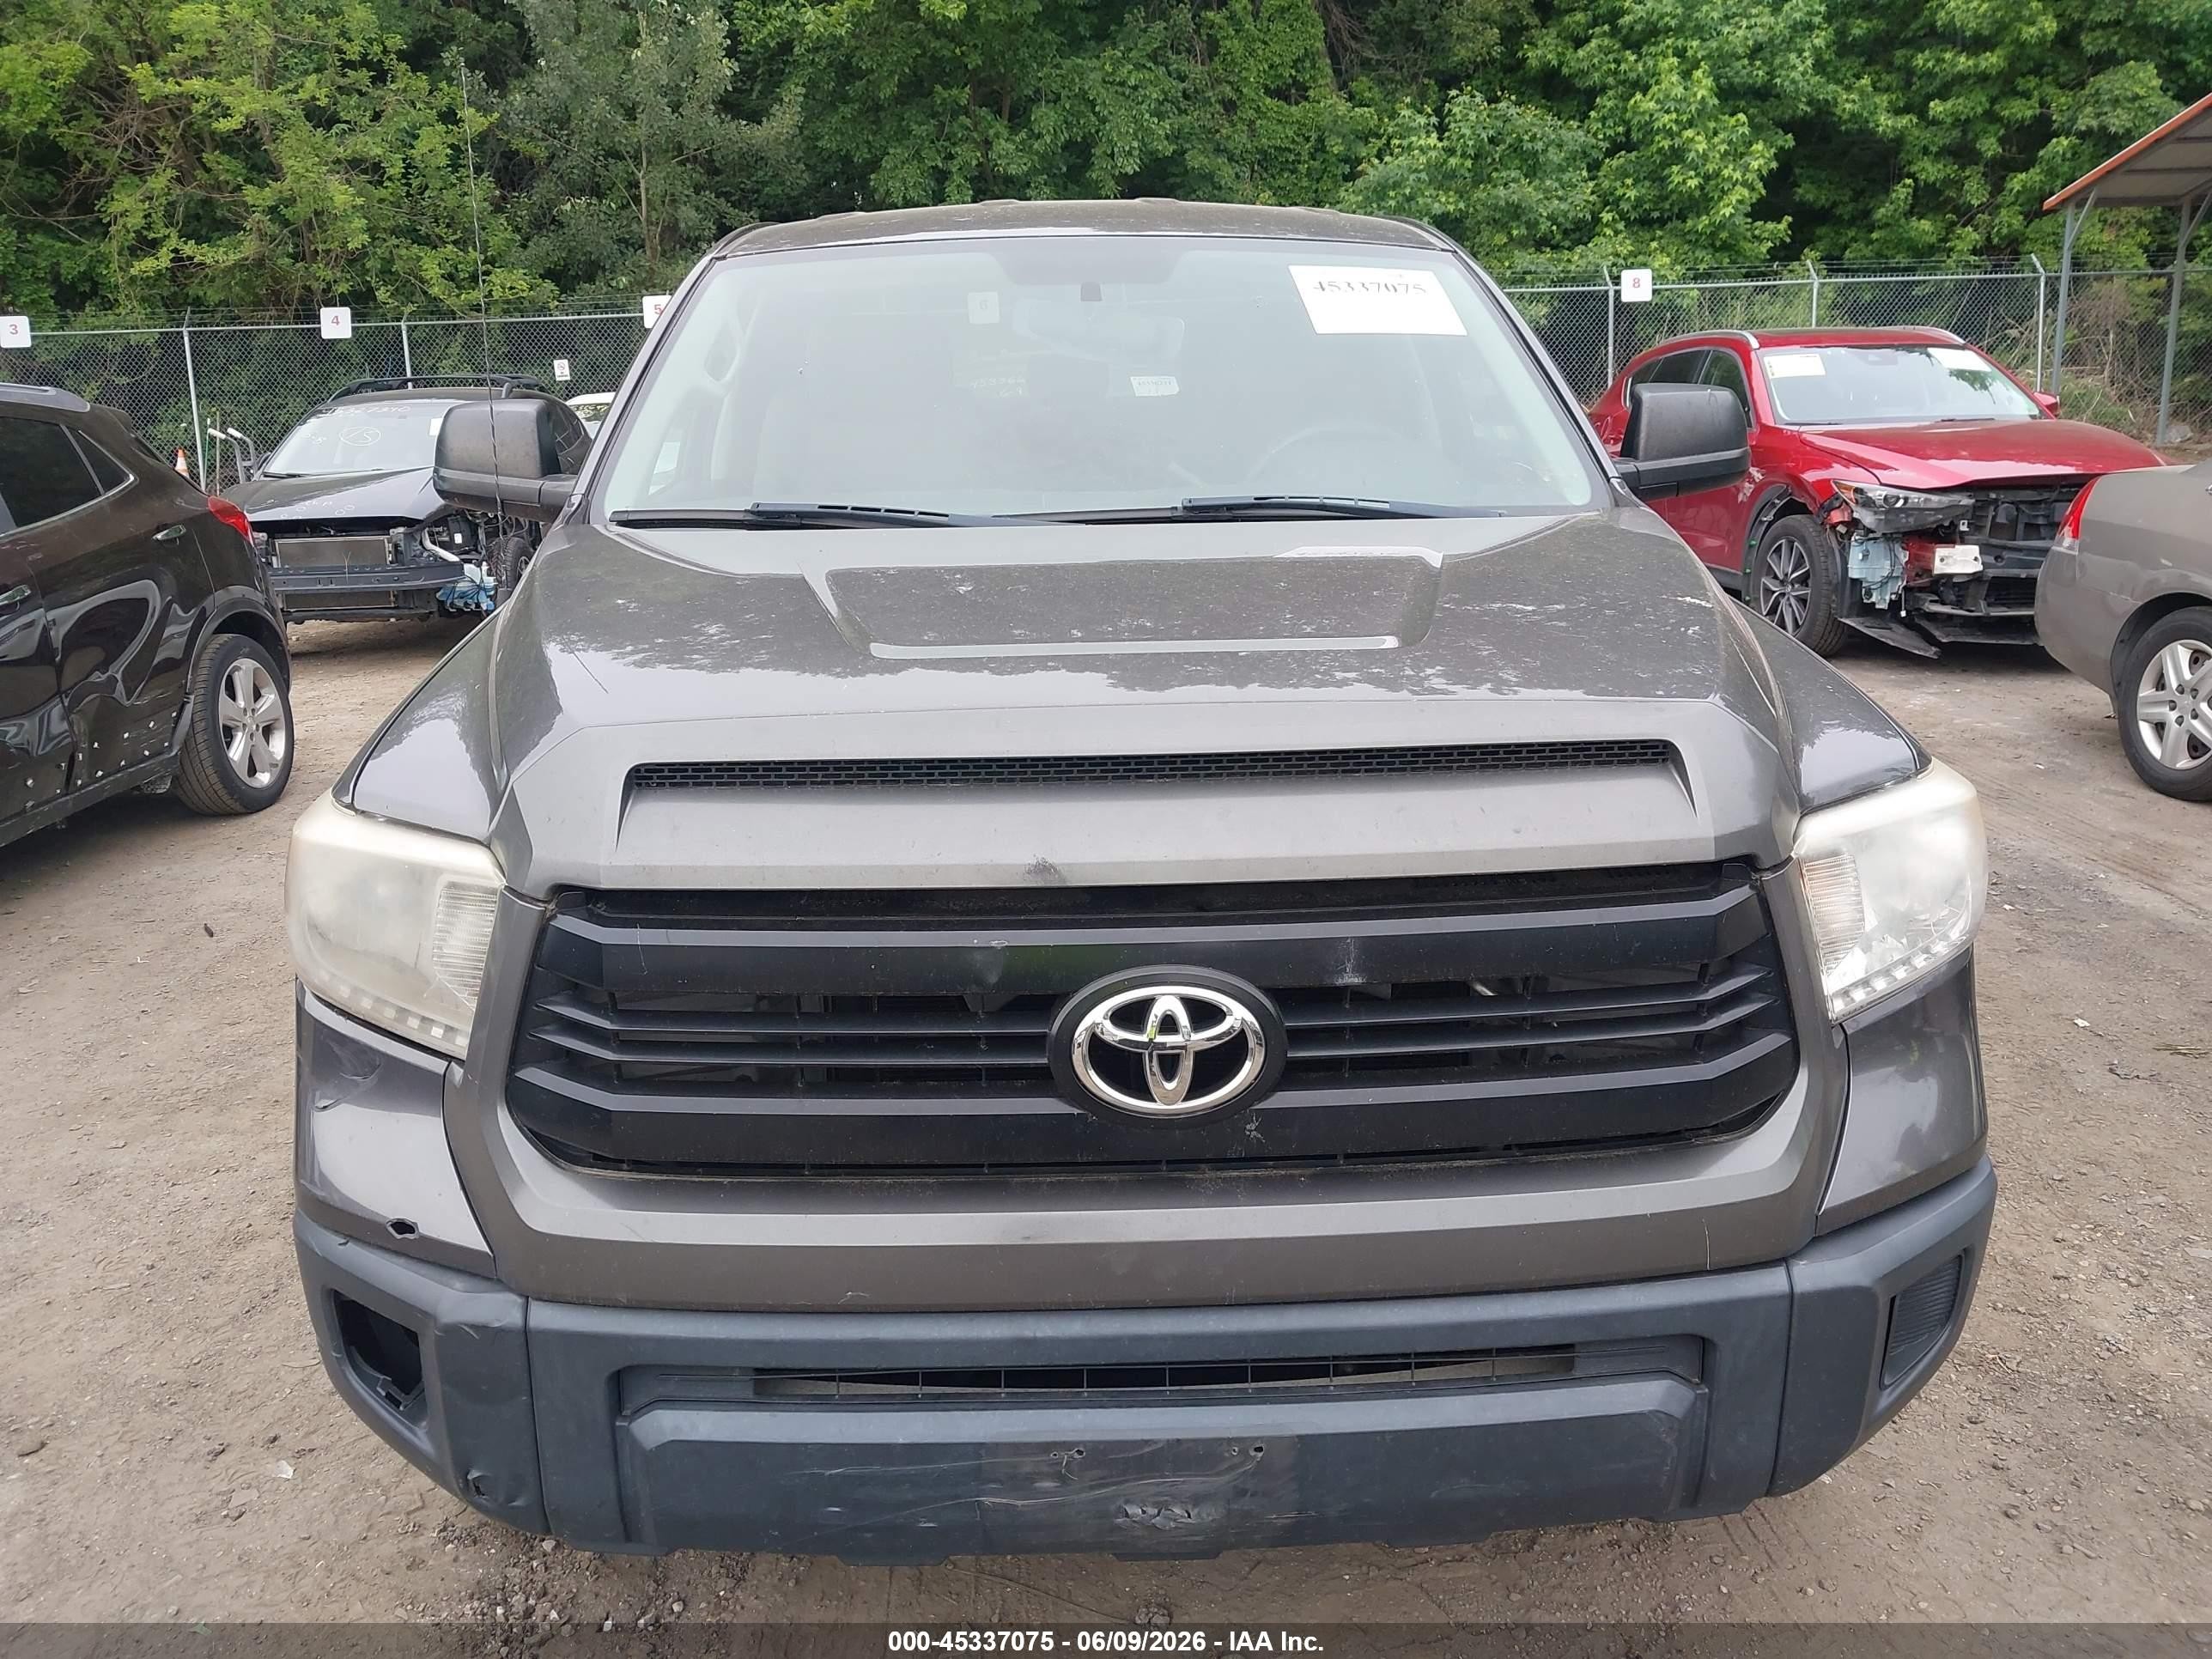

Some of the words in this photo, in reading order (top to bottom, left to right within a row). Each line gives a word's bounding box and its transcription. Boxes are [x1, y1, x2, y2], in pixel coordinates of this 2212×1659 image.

[1313, 280, 1427, 296] 45337075
[1632, 276, 1641, 289] 8
[653, 304, 663, 315] 5
[331, 315, 340, 326] 4
[9, 324, 18, 335] 3
